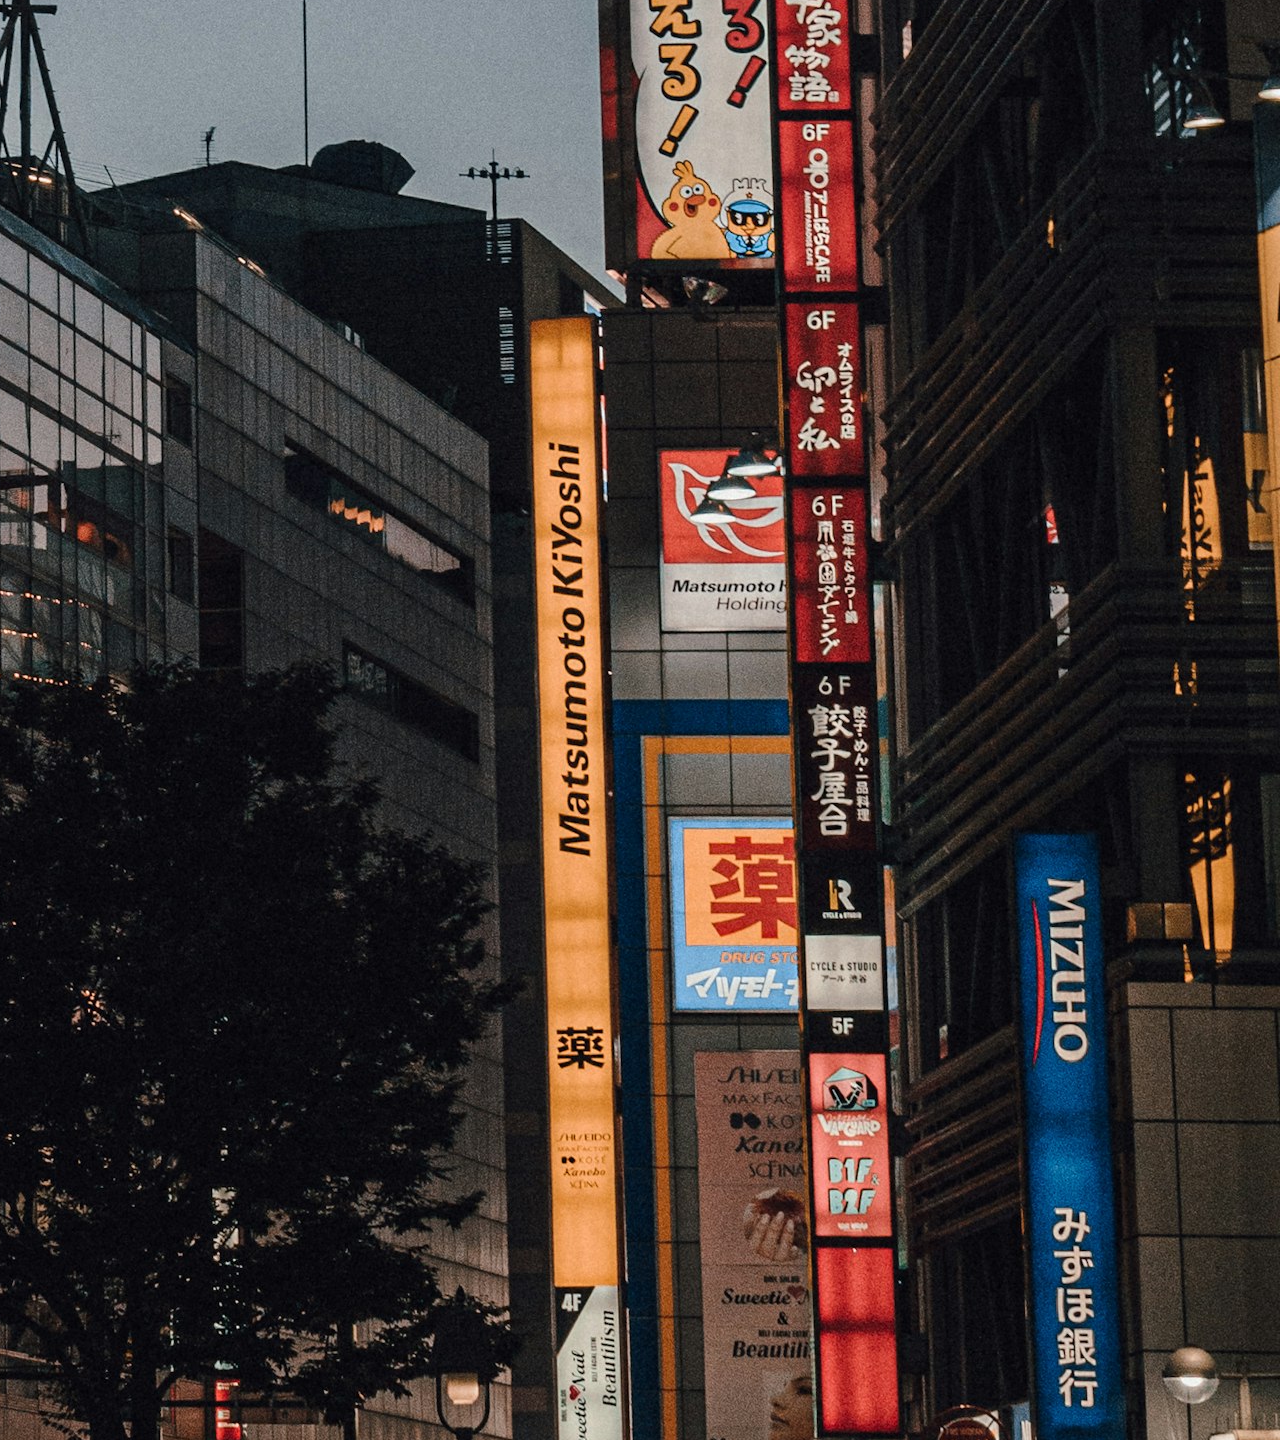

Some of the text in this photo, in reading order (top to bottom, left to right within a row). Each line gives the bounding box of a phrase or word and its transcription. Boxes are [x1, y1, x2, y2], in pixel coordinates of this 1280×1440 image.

[802, 123, 830, 142] 6F
[806, 310, 836, 330] 6F
[837, 342, 856, 440] オムライスの店
[796, 361, 840, 453] 卵と私
[811, 494, 844, 517] 6F
[672, 579, 775, 593] Matsumoto
[549, 442, 591, 858] Matsumoto KiYoshi
[818, 674, 852, 696] 6F
[807, 703, 854, 838] 餃子屋台
[708, 835, 798, 940] 薬
[720, 951, 766, 964] DRUG
[810, 961, 878, 972] CYCLE & STUDIO
[820, 973, 868, 984] アール 渋谷
[1046, 877, 1089, 1064] MIZUHO
[831, 1017, 854, 1036] 5F
[556, 1026, 605, 1069] 薬
[556, 1133, 612, 1143] SHISEIDO
[562, 1167, 607, 1177] Kanebo
[827, 1157, 880, 1186] B1F &
[827, 1187, 877, 1215] B2F
[561, 1292, 582, 1312] 4F
[721, 1288, 790, 1306] Sweetie
[1052, 1206, 1099, 1409] みずほ銀行
[776, 1311, 789, 1325] &
[601, 1309, 618, 1408] Beautilism
[732, 1340, 811, 1359] Beautili
[571, 1349, 587, 1393] Nail
